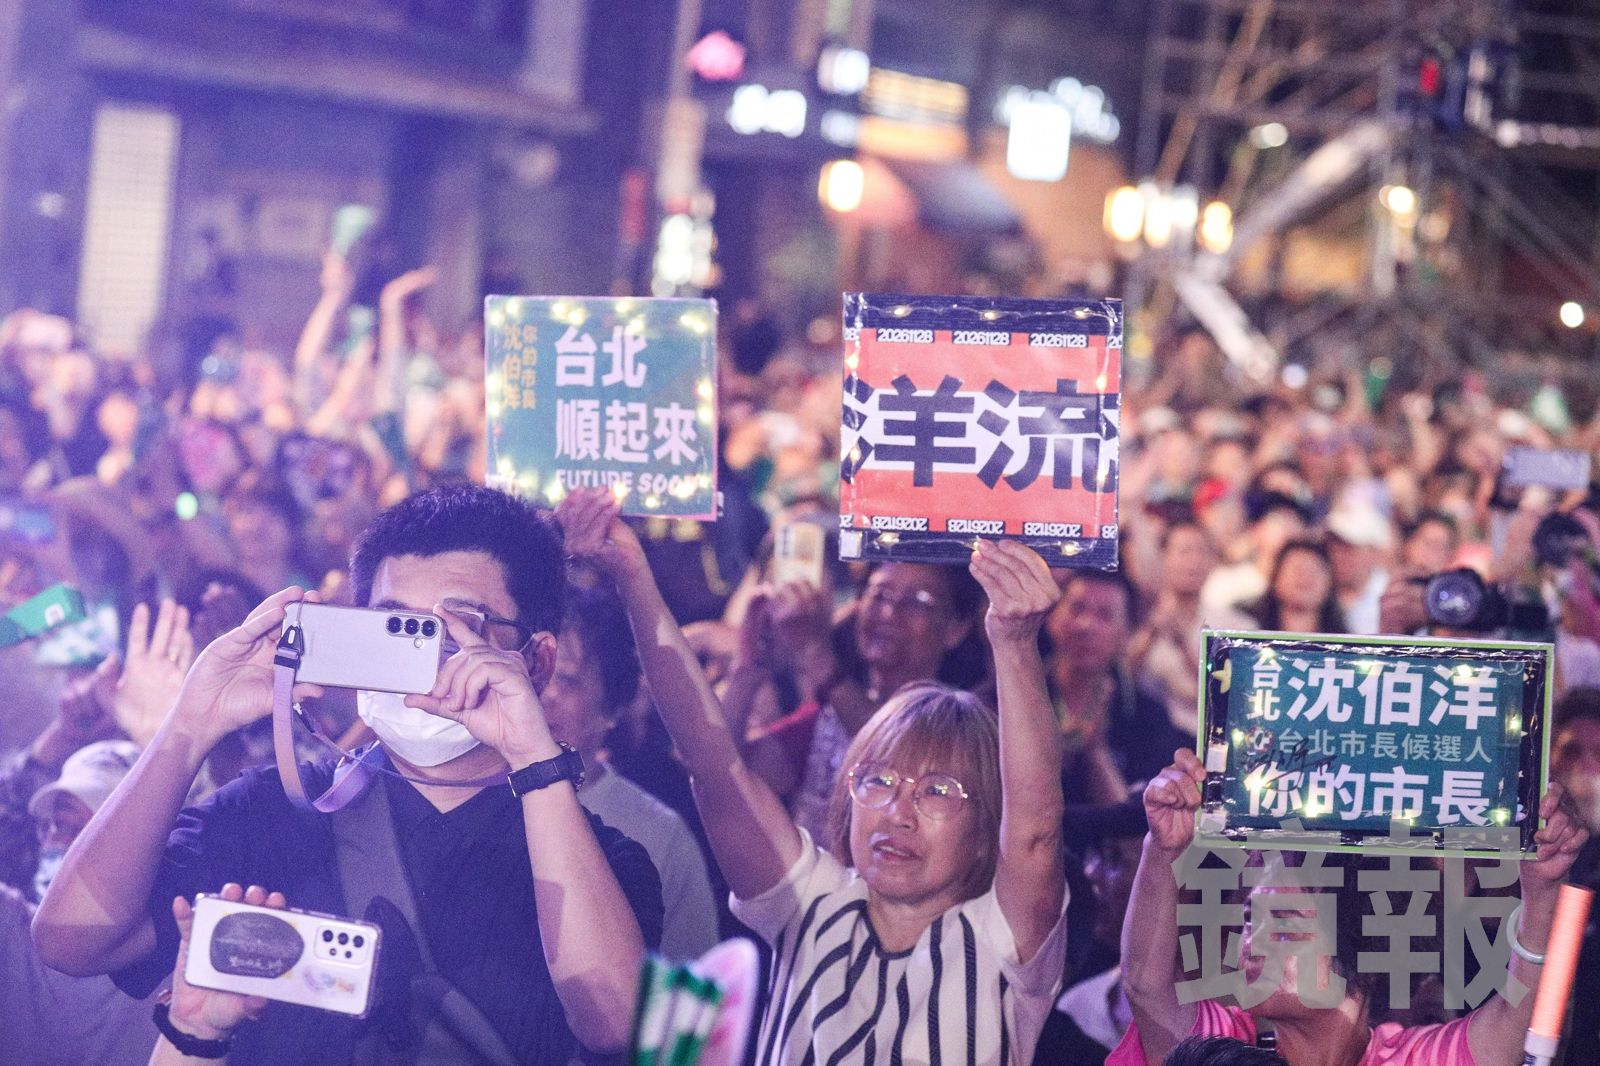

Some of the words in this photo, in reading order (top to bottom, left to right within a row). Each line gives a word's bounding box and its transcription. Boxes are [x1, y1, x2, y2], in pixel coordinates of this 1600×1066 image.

[554, 326, 648, 388] 台北
[877, 328, 934, 344] 20261128
[953, 331, 1011, 346] 20261128
[1030, 333, 1087, 348] 20261128
[554, 399, 699, 466] 順起來
[841, 374, 1119, 493] 洋流
[872, 515, 928, 531] 20261128
[947, 518, 1004, 534] 20261128
[1024, 521, 1081, 537] 20261128
[1246, 654, 1282, 721] 台北
[1286, 657, 1498, 731] 沈伯洋
[1277, 728, 1492, 765] 台北市長候選人
[1243, 762, 1491, 827] 你的市長
